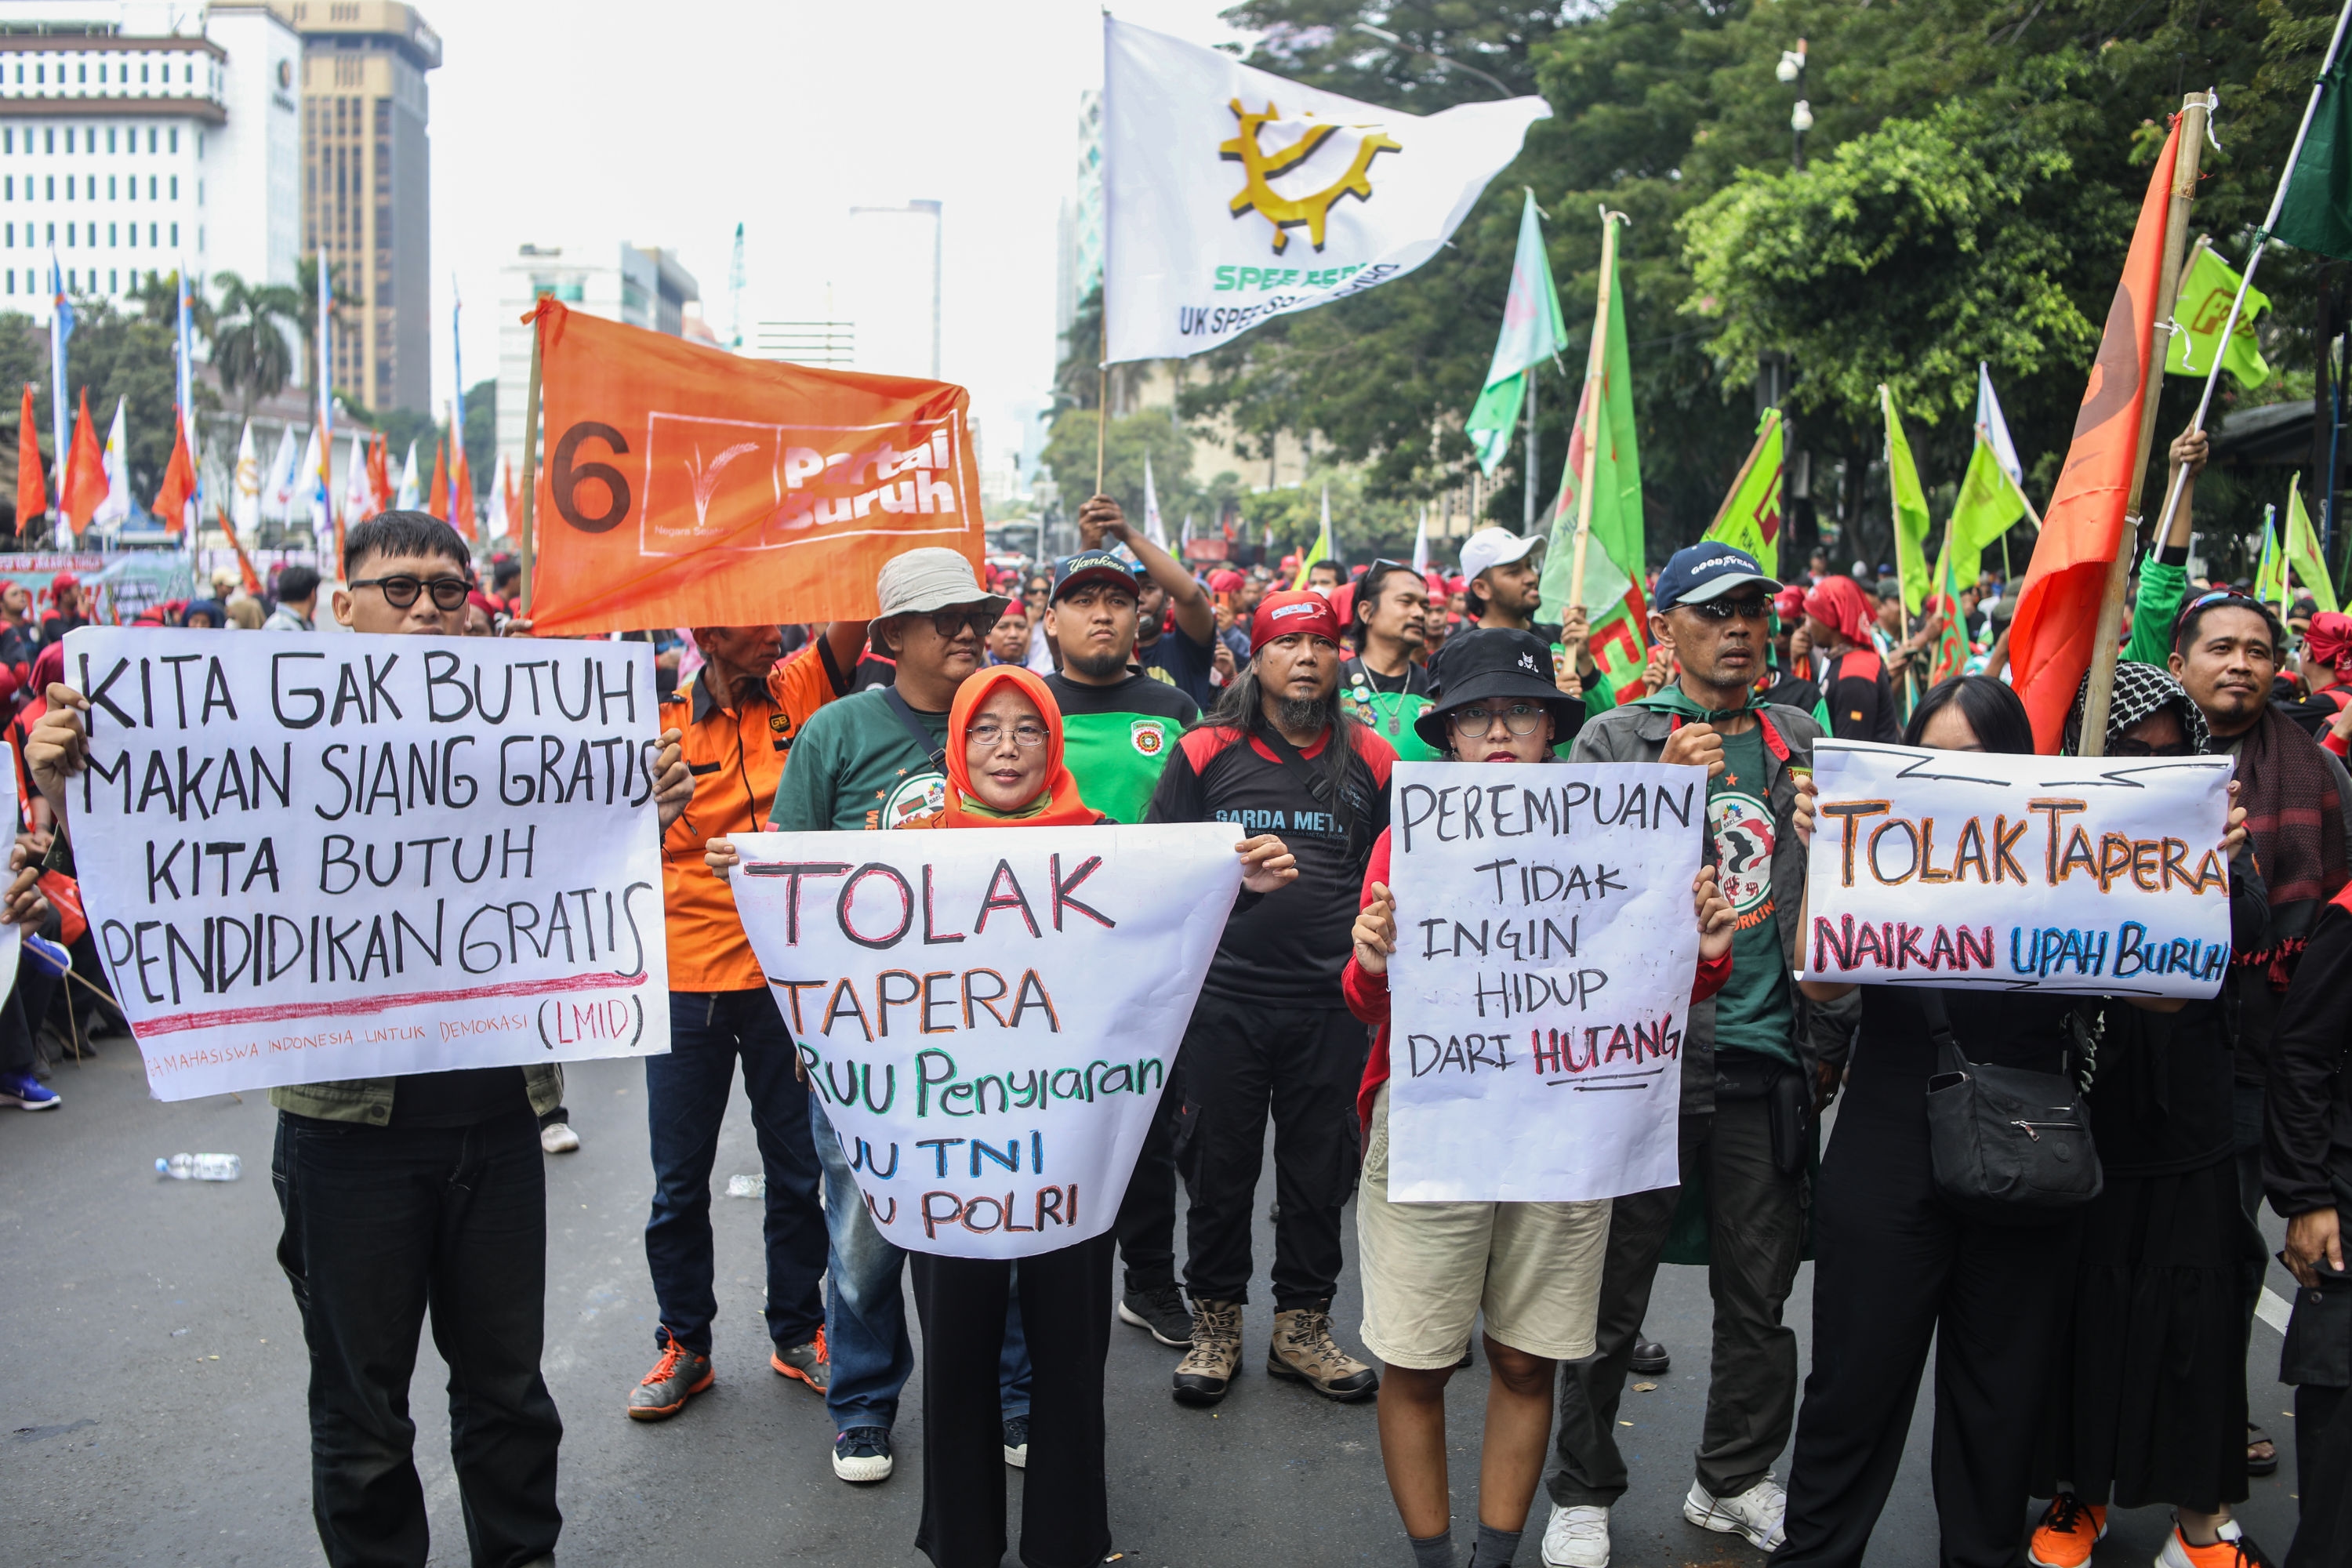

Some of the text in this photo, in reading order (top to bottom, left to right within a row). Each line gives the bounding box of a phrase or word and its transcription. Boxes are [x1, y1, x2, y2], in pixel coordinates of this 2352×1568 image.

[1181, 306, 1209, 336] UK
[551, 421, 631, 533] 6
[784, 429, 950, 489] Partai
[655, 524, 691, 538] Negara
[774, 470, 956, 530] Buruh
[80, 650, 636, 737] KITA GAK BUTUH
[82, 735, 655, 822] MAKAN SIANG GRATIS
[1216, 810, 1286, 829] GARDA
[1400, 782, 1694, 853] PEREMPUAN
[1819, 797, 2229, 896] TOLAK TAPERA
[146, 825, 535, 904] KITA BUTUH
[1474, 858, 1628, 907] TIDAK
[743, 852, 1116, 950] TOLAK
[102, 881, 653, 1011] PENDIDIKAN GRATIS
[1418, 914, 1579, 961] INGIN
[1813, 913, 2230, 982] NAIKAN UPAH BURUH
[768, 967, 1062, 1043] TAPERA
[1475, 968, 1609, 1019] HIDUP
[164, 1042, 259, 1073] MAHASISWA
[268, 1029, 354, 1054] INDONESIA
[440, 1014, 528, 1043] DEMOKASI
[538, 994, 644, 1051] (LMID)
[1408, 1012, 1682, 1079] DARI HUTANG
[797, 1040, 1164, 1119] RUU Penyiaran
[834, 1129, 1043, 1180] UU TNI
[922, 1182, 1078, 1240] POLRI
